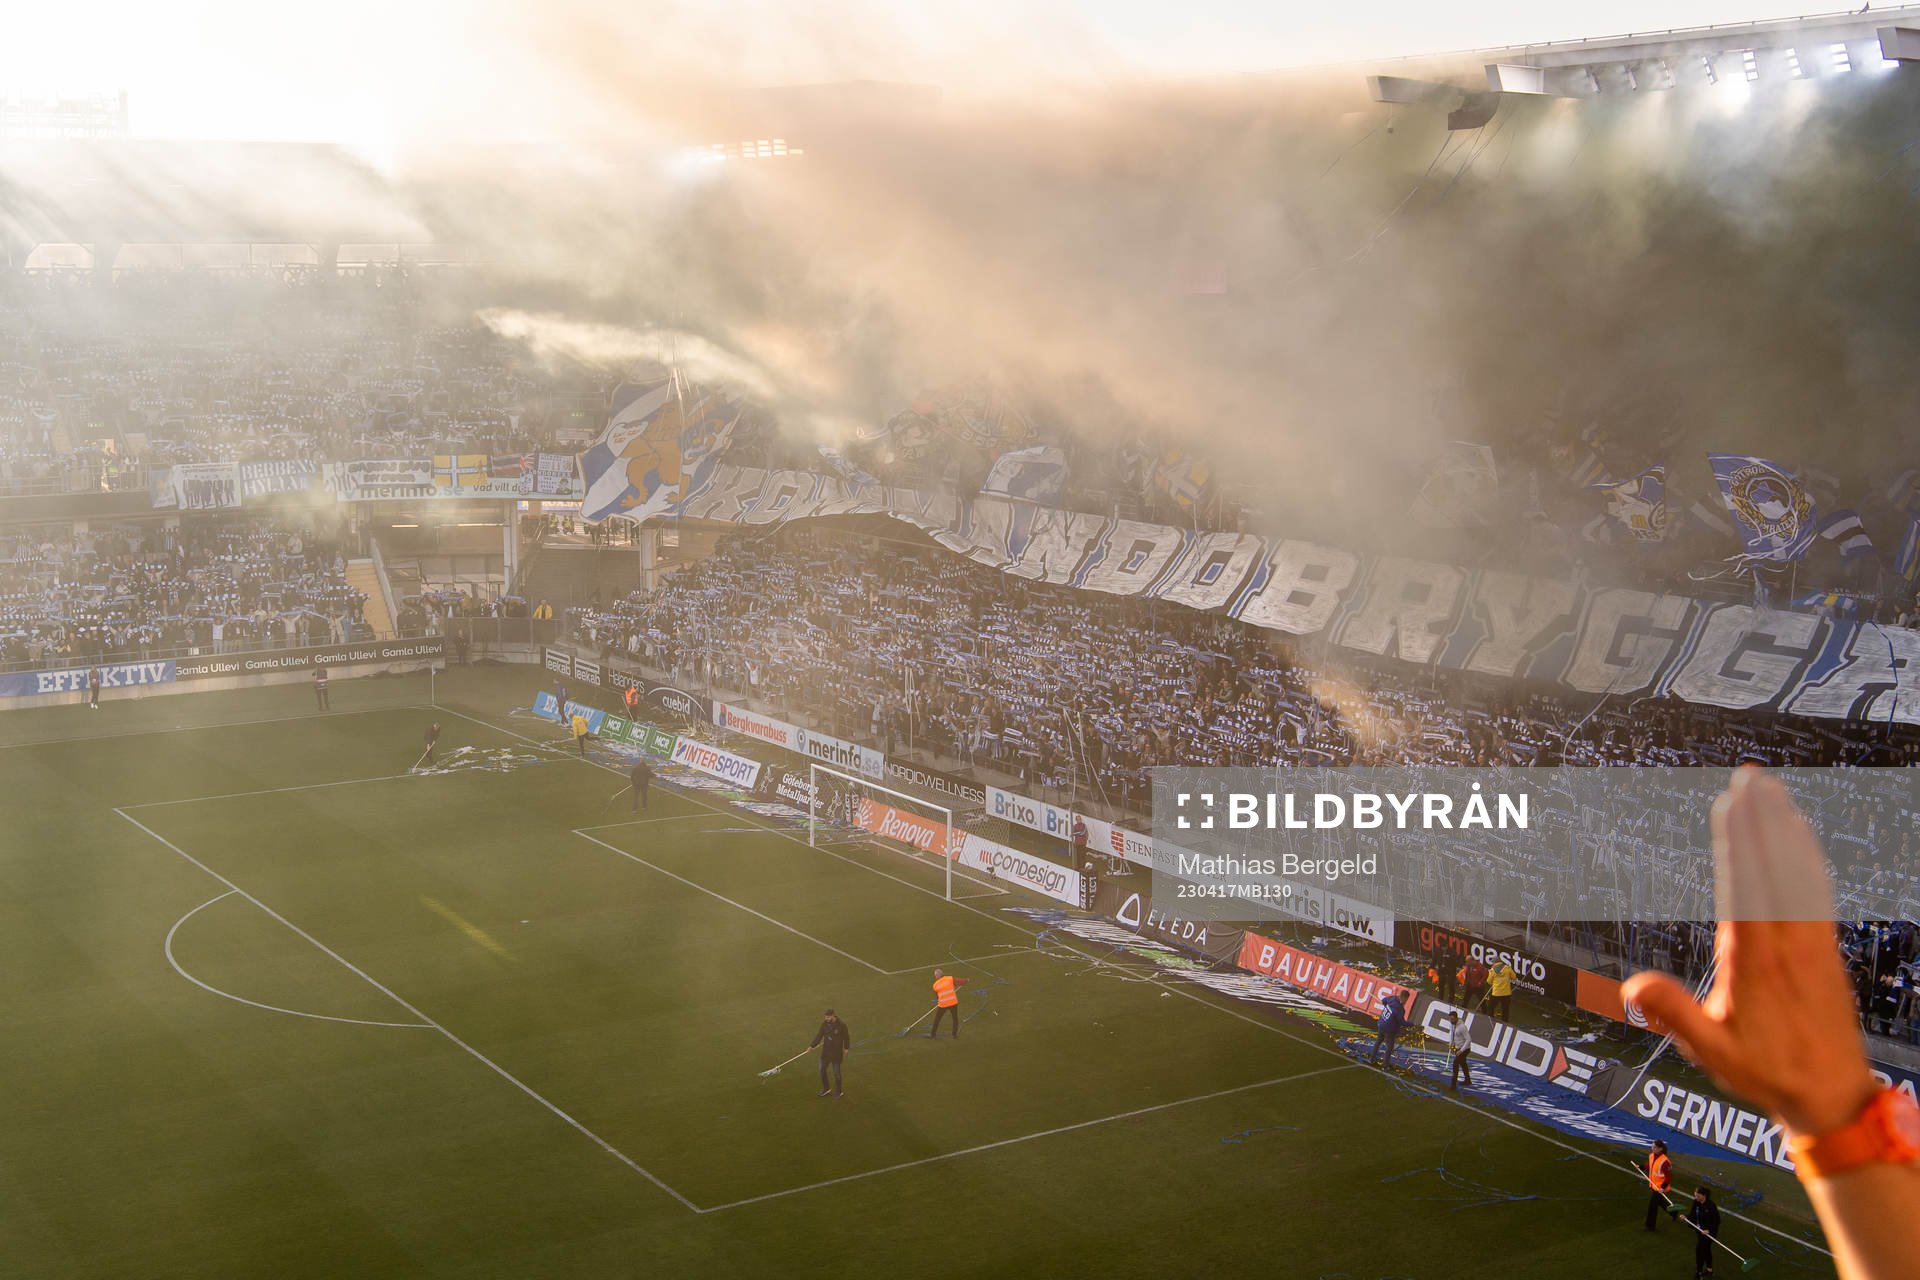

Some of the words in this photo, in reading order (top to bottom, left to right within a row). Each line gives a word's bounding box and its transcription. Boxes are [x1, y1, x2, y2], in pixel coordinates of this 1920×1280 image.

[314, 652, 347, 664] Gamla
[349, 649, 377, 661] Ullevi
[382, 647, 413, 658] Gamla
[415, 644, 442, 655] Ullevi
[176, 666, 208, 676] Gamla
[210, 661, 239, 674] Ullevi
[245, 659, 279, 670] Gamla
[281, 655, 309, 667] Ullevi
[662, 695, 691, 715] cuebid
[607, 719, 622, 731] MCR
[631, 727, 645, 740] MCR
[727, 711, 788, 744] Bergkvarabuss
[654, 735, 670, 749] MCR
[684, 745, 756, 783] INTERSPORT
[808, 738, 880, 776] merinfo.se
[879, 808, 935, 848] Renova
[1146, 908, 1209, 946] ELEDA
[1330, 898, 1374, 936] law.
[1258, 944, 1394, 1011] BAUHAUS
